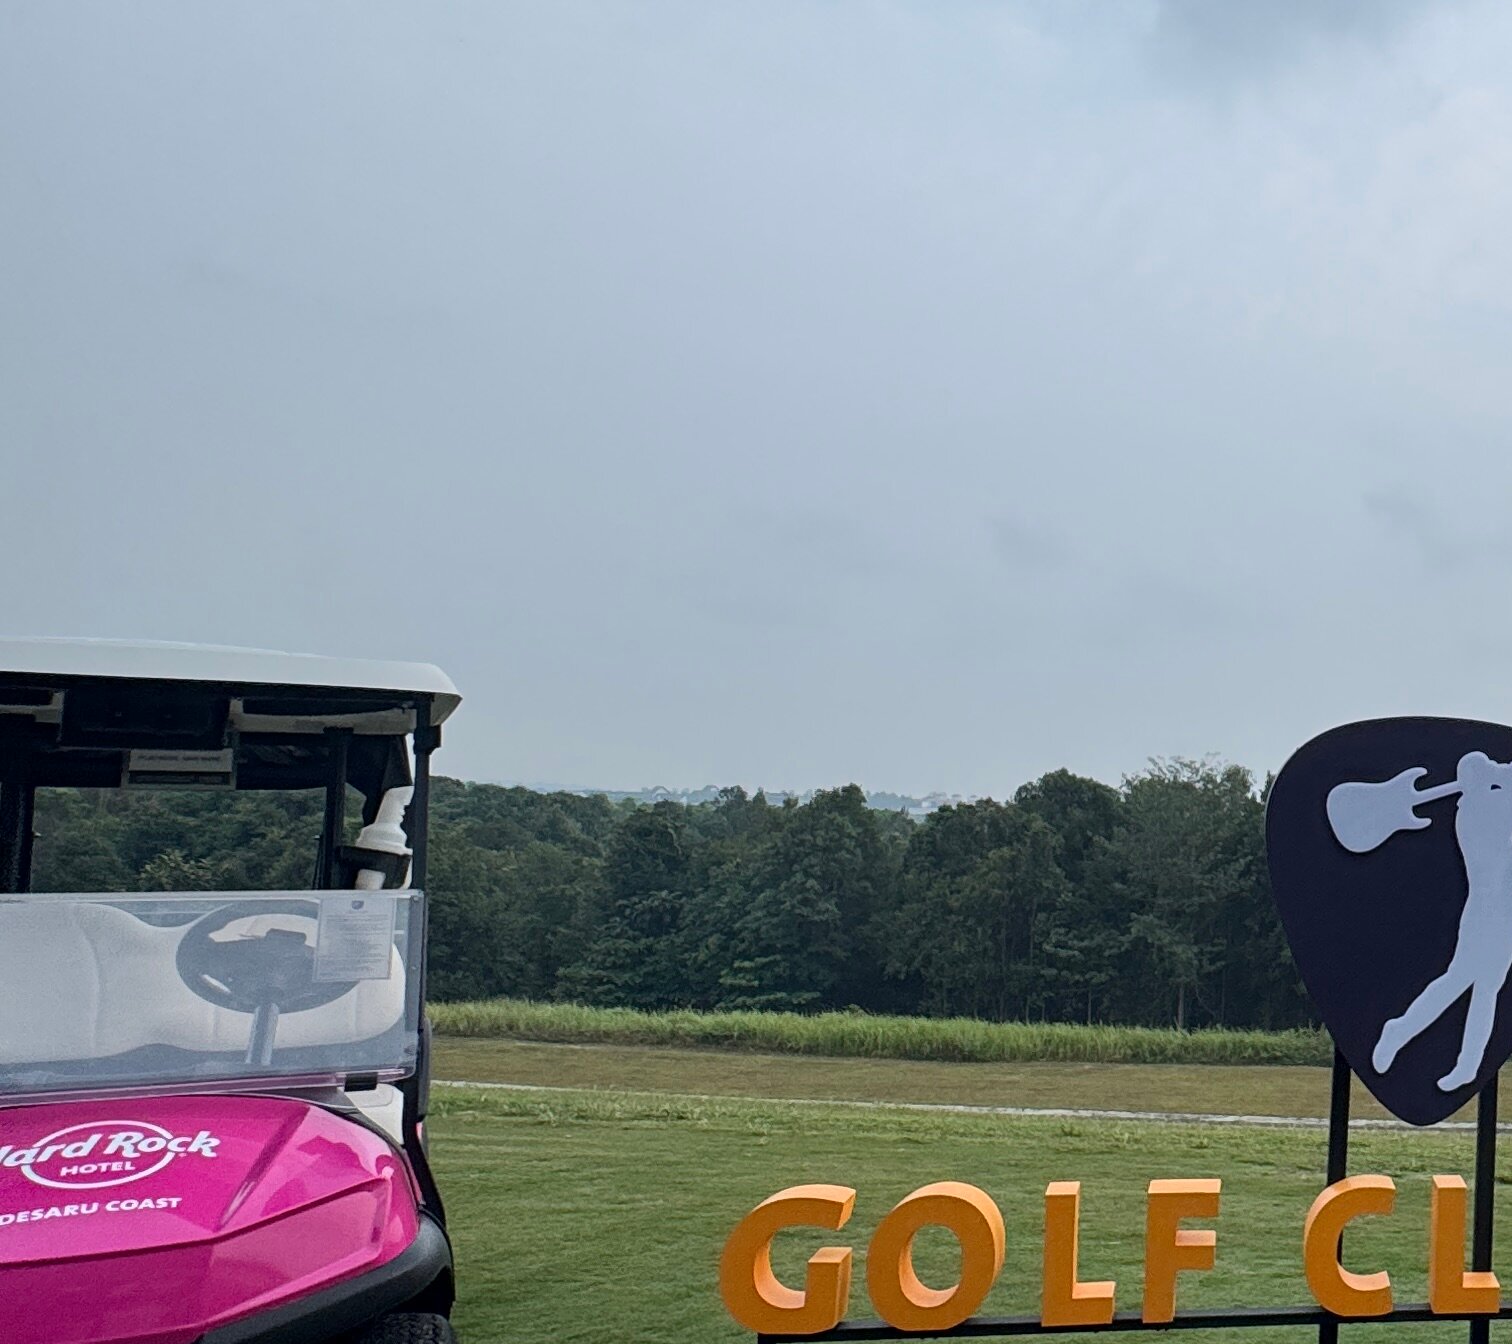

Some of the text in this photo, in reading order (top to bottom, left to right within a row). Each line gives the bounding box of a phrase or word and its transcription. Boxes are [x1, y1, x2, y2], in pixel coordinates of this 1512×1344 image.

[104, 1131, 220, 1157] Rock
[60, 1161, 136, 1176] HOTEL
[0, 1197, 182, 1226] DESARU COAST
[719, 1178, 1221, 1335] GOLF
